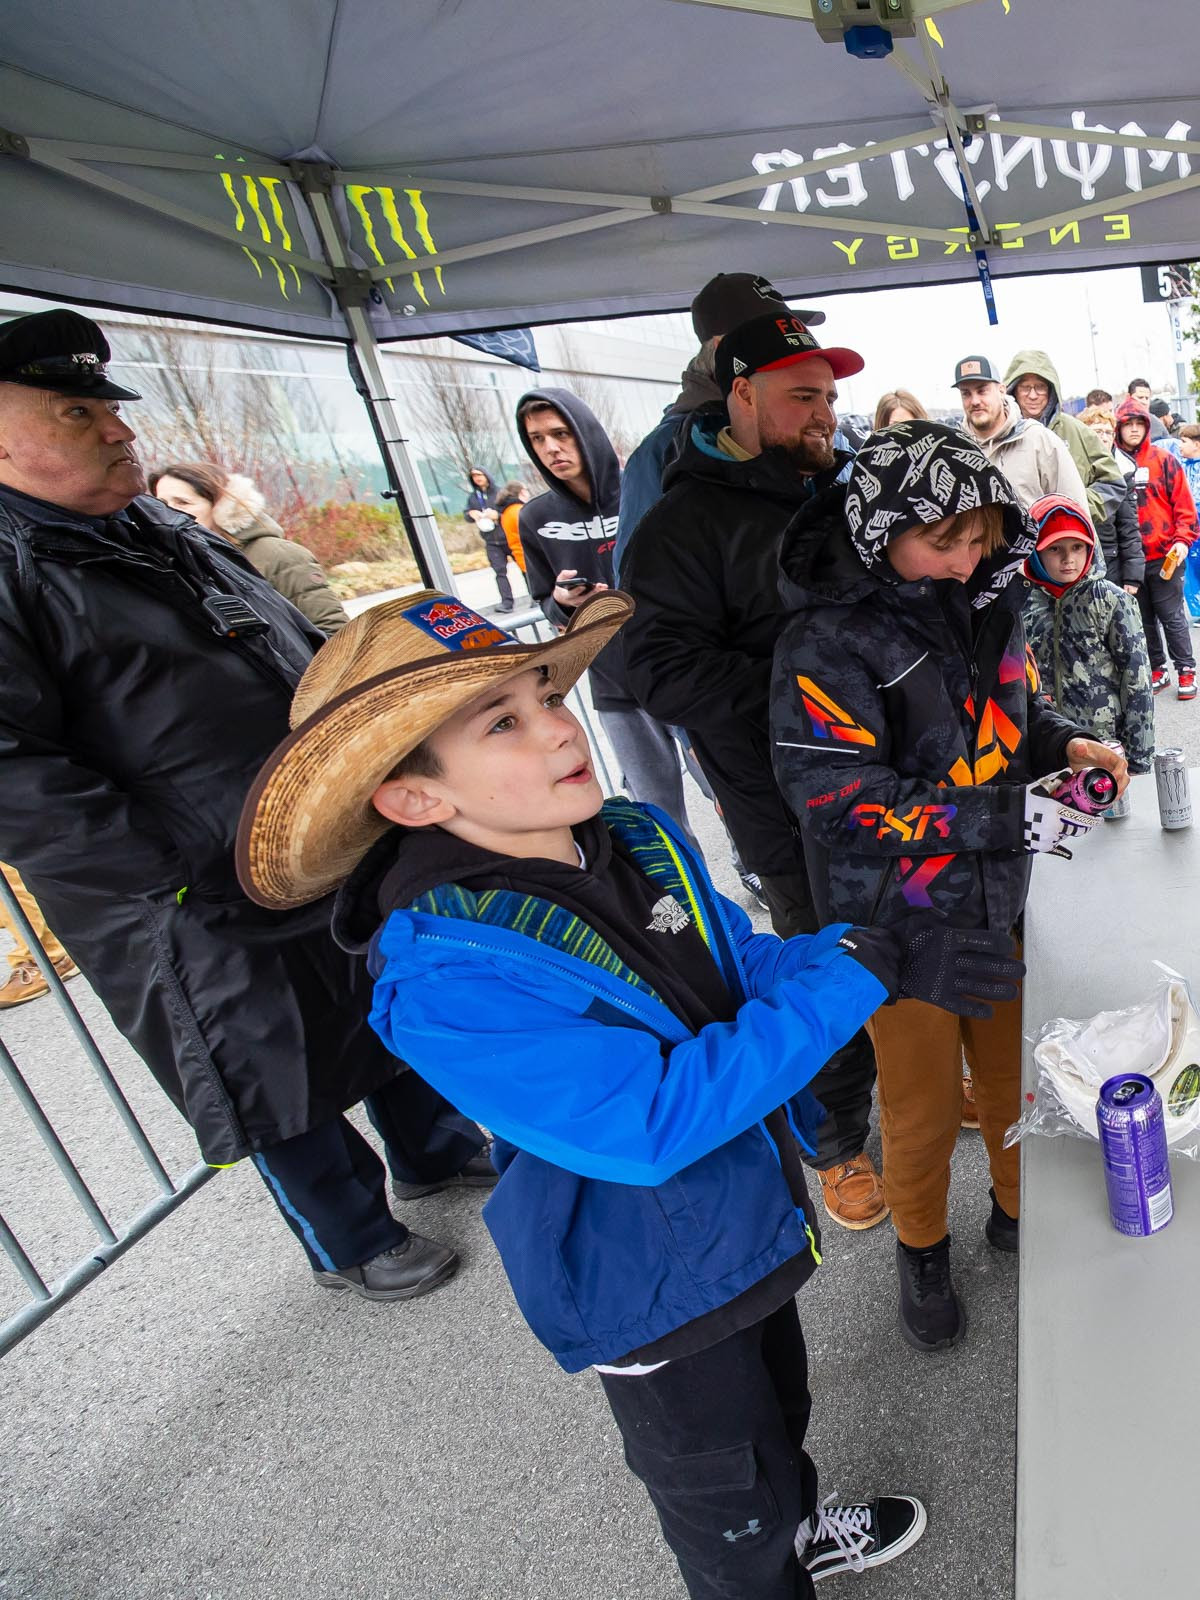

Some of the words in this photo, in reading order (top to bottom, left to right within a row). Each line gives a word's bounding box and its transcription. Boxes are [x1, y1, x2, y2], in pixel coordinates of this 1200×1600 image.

[775, 318, 807, 335] FO
[905, 433, 935, 463] NIKE
[952, 452, 991, 472] NIKE
[537, 515, 620, 541] asta
[806, 792, 837, 808] RIDE
[839, 777, 862, 798] DIV
[848, 803, 958, 842] FXR
